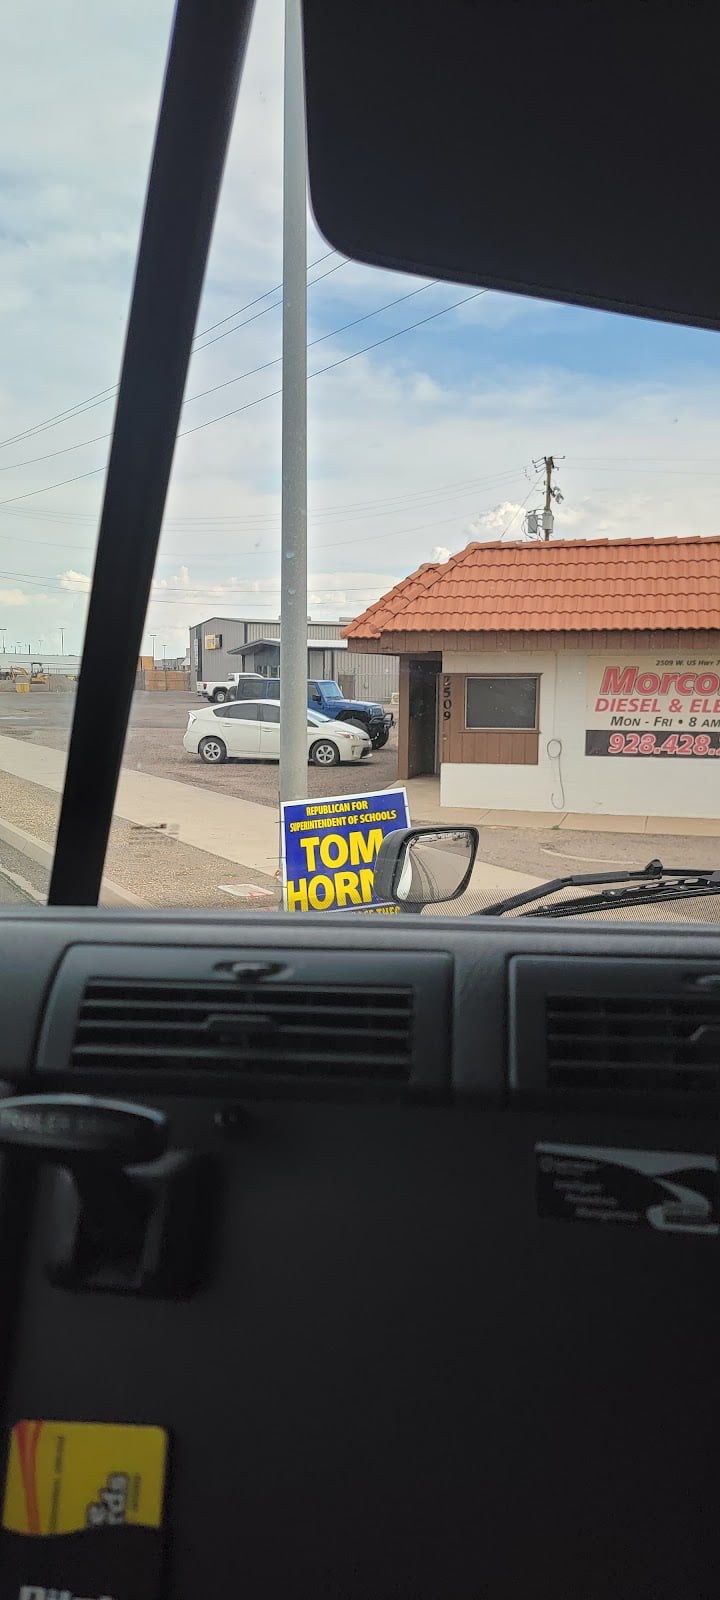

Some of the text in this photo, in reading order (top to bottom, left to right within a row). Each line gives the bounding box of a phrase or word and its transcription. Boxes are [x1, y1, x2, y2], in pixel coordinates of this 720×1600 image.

[600, 666, 720, 696] Morco
[594, 698, 661, 713] DIESEL
[668, 699, 682, 713] &
[688, 717, 698, 728] 8
[608, 733, 720, 755] 928.428.
[306, 800, 369, 816] REPUBLICAN FOR
[290, 810, 397, 832] SUPERINTENDENT OF SCHOOLS
[300, 829, 384, 872] TOM
